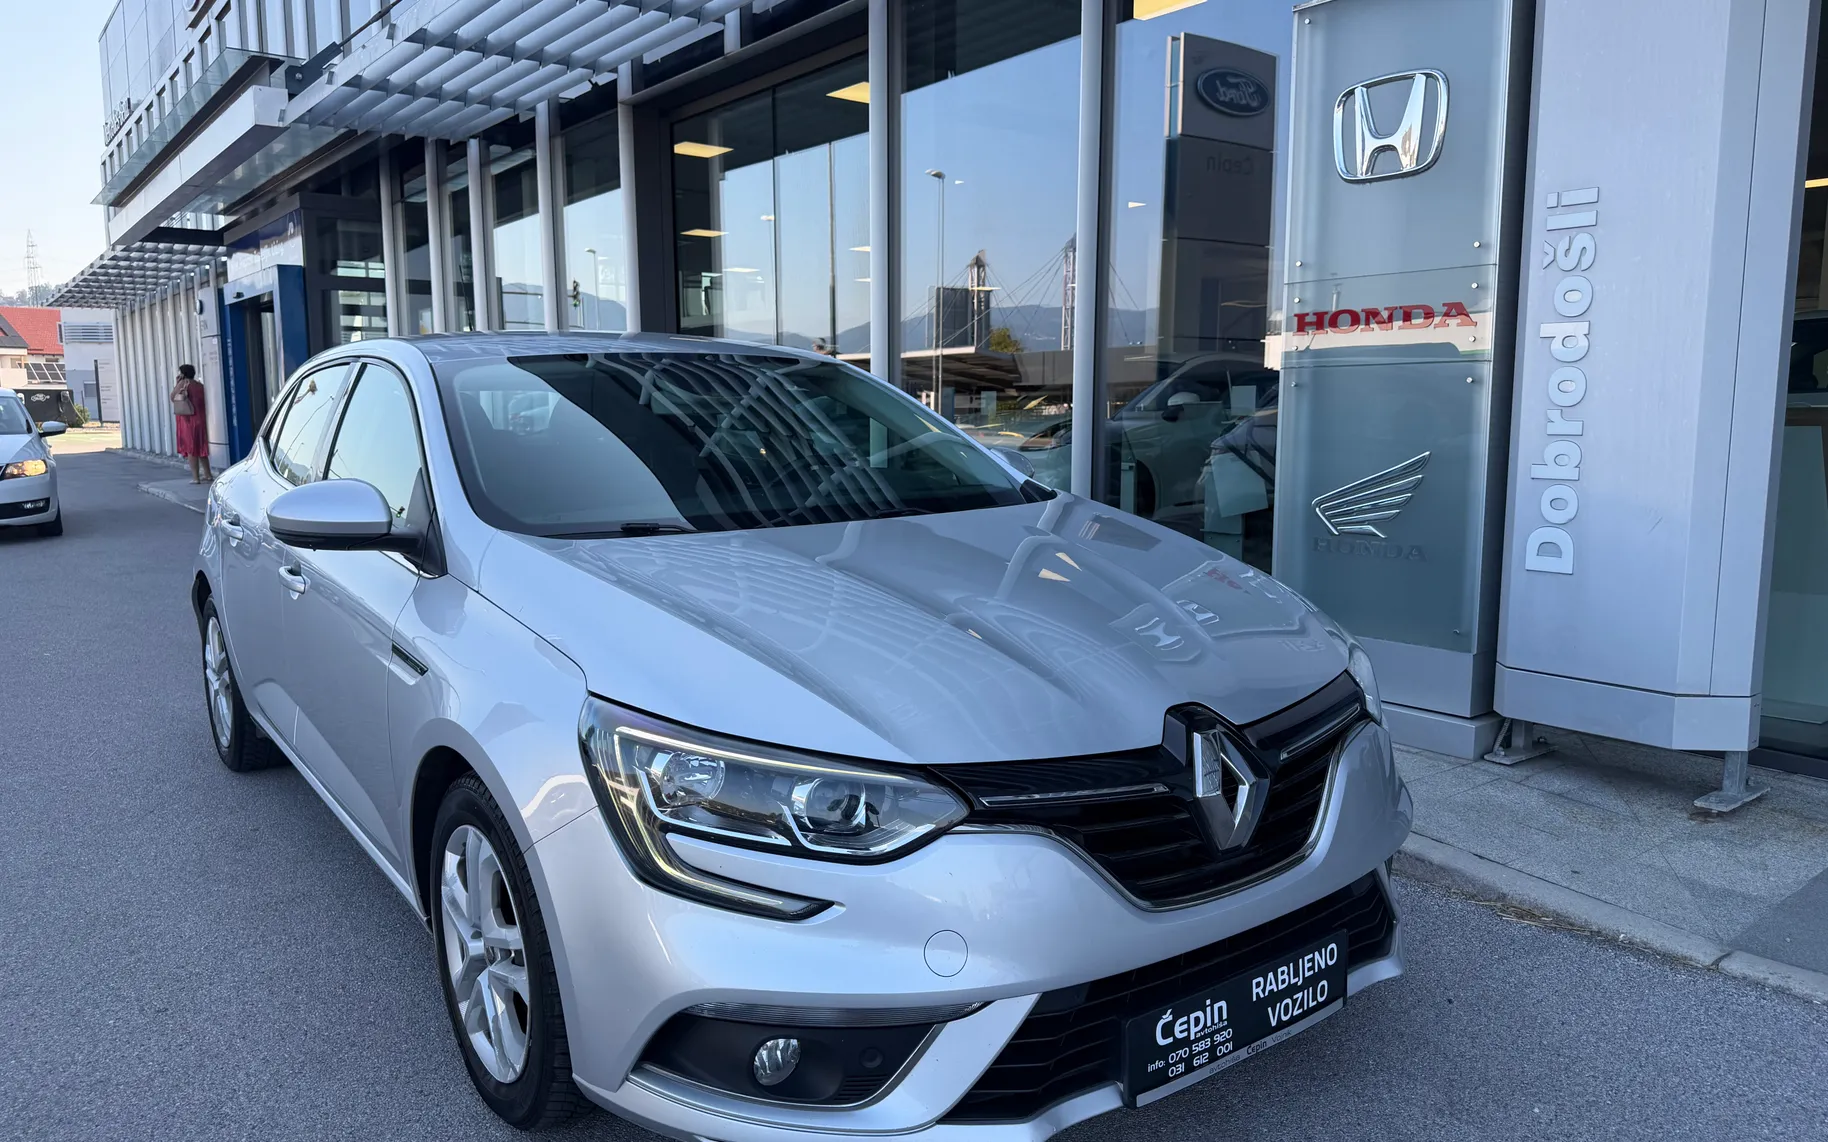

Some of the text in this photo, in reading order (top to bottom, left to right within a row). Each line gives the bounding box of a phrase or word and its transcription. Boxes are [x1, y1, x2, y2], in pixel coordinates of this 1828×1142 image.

[1292, 301, 1478, 337] HONDA
[1525, 186, 1600, 575] Dobrodošli
[1311, 536, 1428, 562] HONDA
[1251, 942, 1338, 1002] RABLJENO
[1155, 998, 1228, 1046] Čepin
[1267, 979, 1328, 1027] VOZILO
[1147, 1028, 1233, 1073] info: 070 583 920
[1168, 1041, 1233, 1078] 031 612 001
